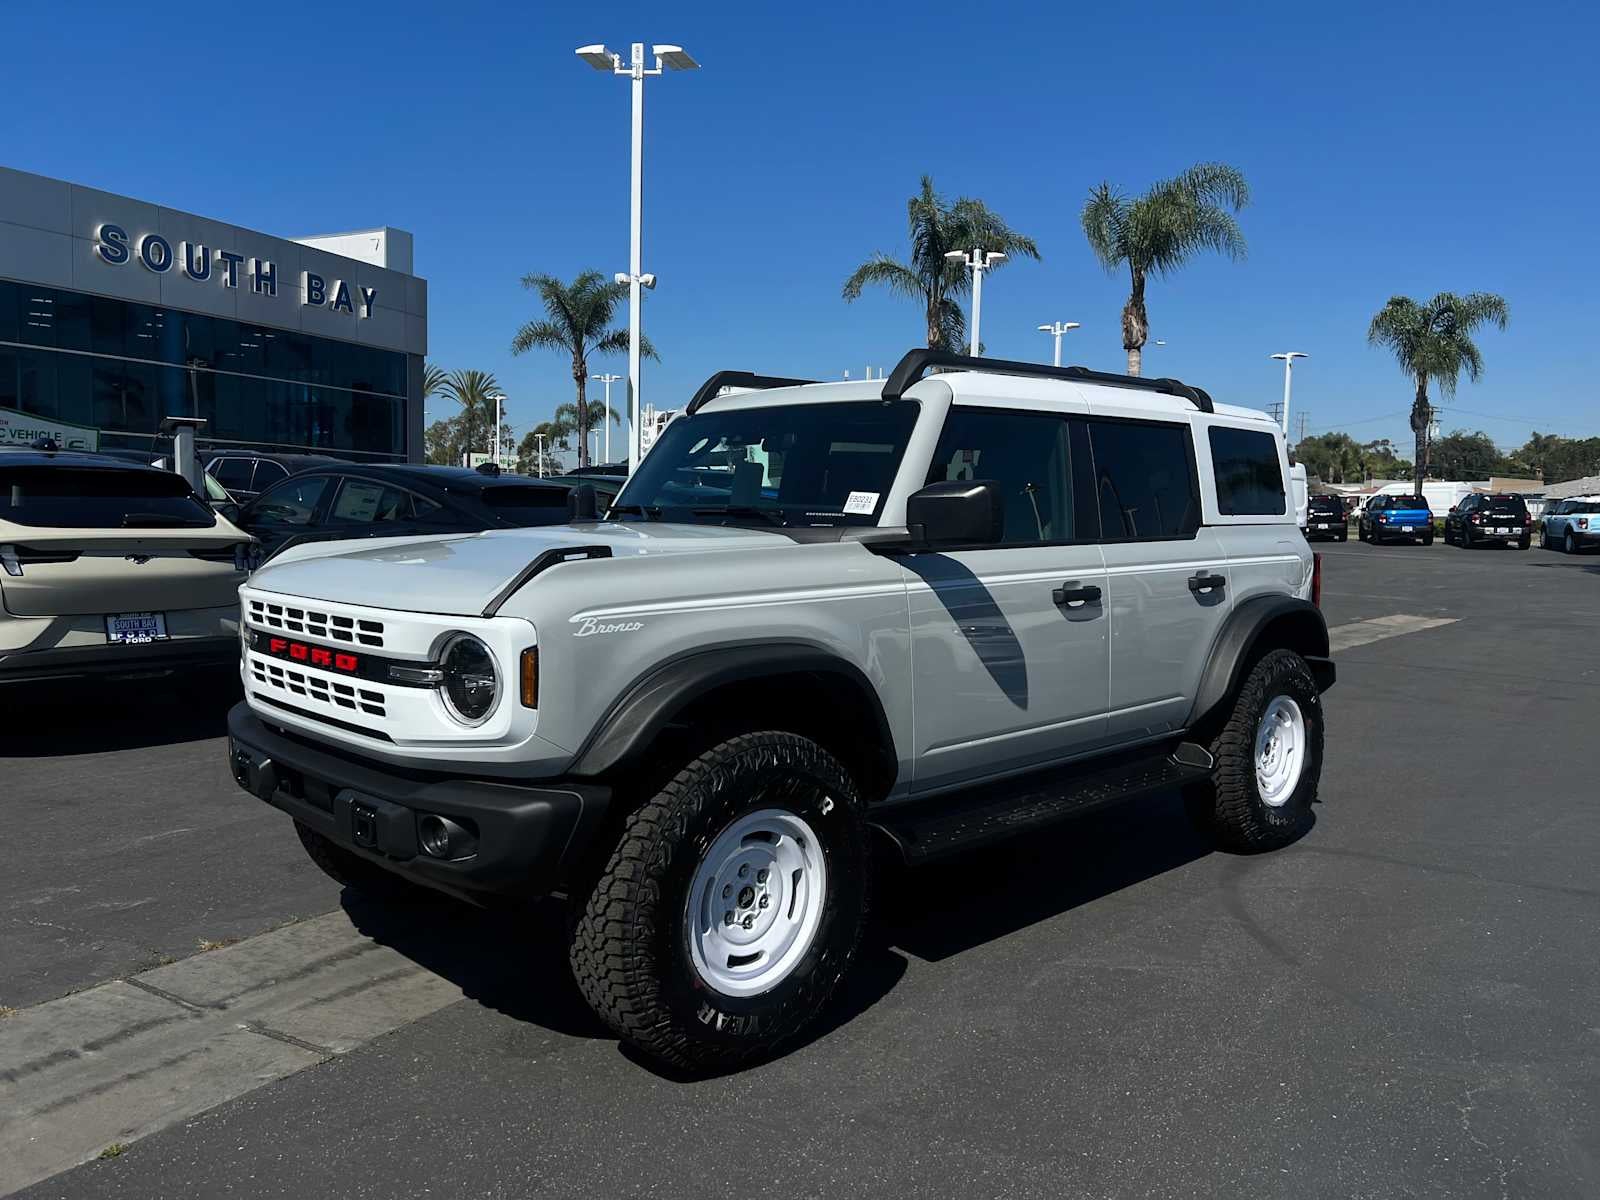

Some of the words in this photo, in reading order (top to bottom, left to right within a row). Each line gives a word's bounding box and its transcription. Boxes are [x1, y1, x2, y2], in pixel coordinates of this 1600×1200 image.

[96, 223, 278, 297] SOUTH
[301, 270, 378, 320] BAY
[9, 429, 62, 442] VEHICLE
[115, 620, 139, 629] SOUTH
[142, 619, 156, 629] BAY
[572, 616, 644, 637] Bronco
[126, 636, 152, 644] FORD
[270, 638, 358, 671] FORD
